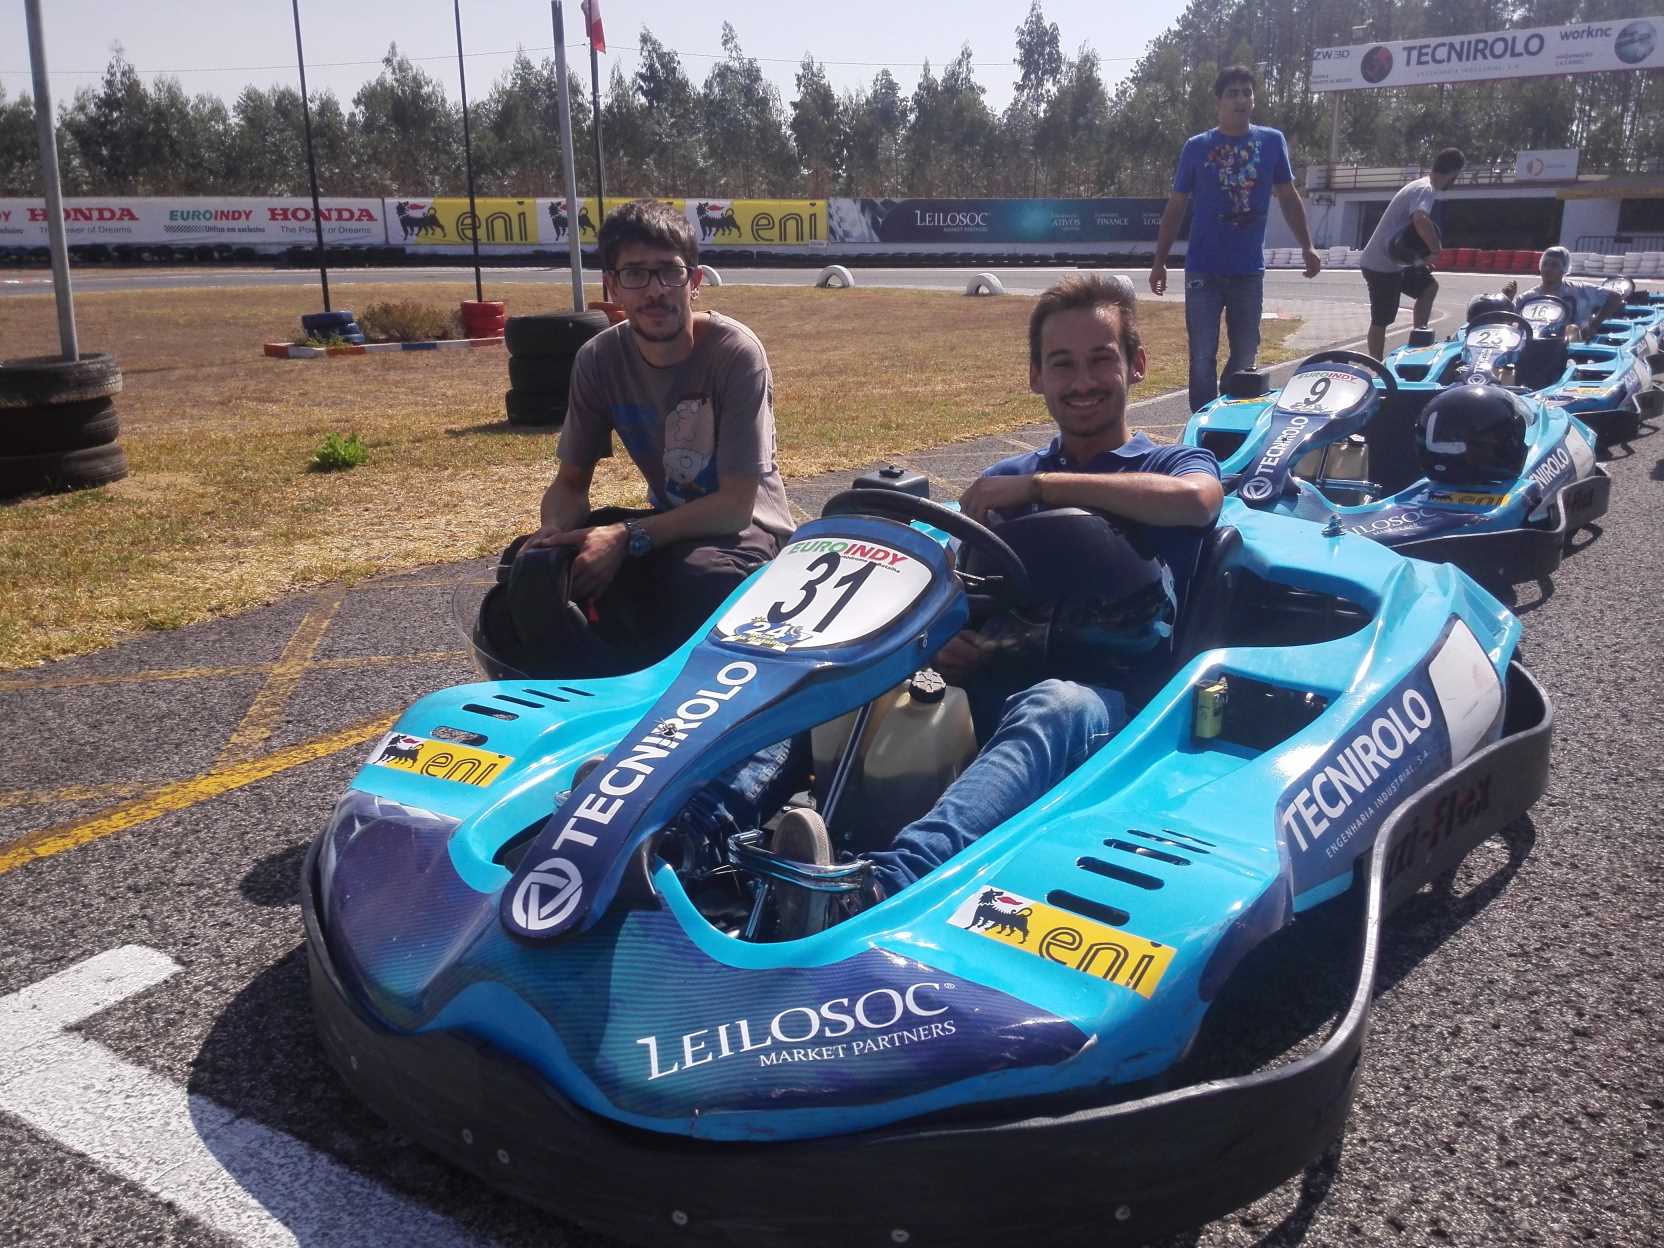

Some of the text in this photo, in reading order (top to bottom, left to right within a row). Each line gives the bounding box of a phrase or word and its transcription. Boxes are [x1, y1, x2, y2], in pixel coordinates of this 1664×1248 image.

[1402, 33, 1545, 67] TECNIROLO
[169, 209, 253, 222] EUROINDY
[268, 207, 378, 222] HONDA
[456, 201, 528, 242] eni
[751, 202, 818, 242] eni
[914, 209, 989, 226] LEILOSOC
[1303, 377, 1331, 406] 9
[1529, 447, 1569, 489] NIROLO
[1351, 509, 1437, 535] ILOSOC
[788, 541, 909, 566] EUROINDY
[767, 551, 877, 633] 31
[421, 752, 505, 786] eni
[552, 660, 758, 851] TECNIROLO
[1281, 688, 1432, 852] TECNIROLO
[1326, 807, 1375, 859] ENGENHARIA
[1039, 926, 1163, 991] eni
[636, 982, 950, 1081] LEILOSOC
[759, 1019, 957, 1068] MARKET PARTNERS
